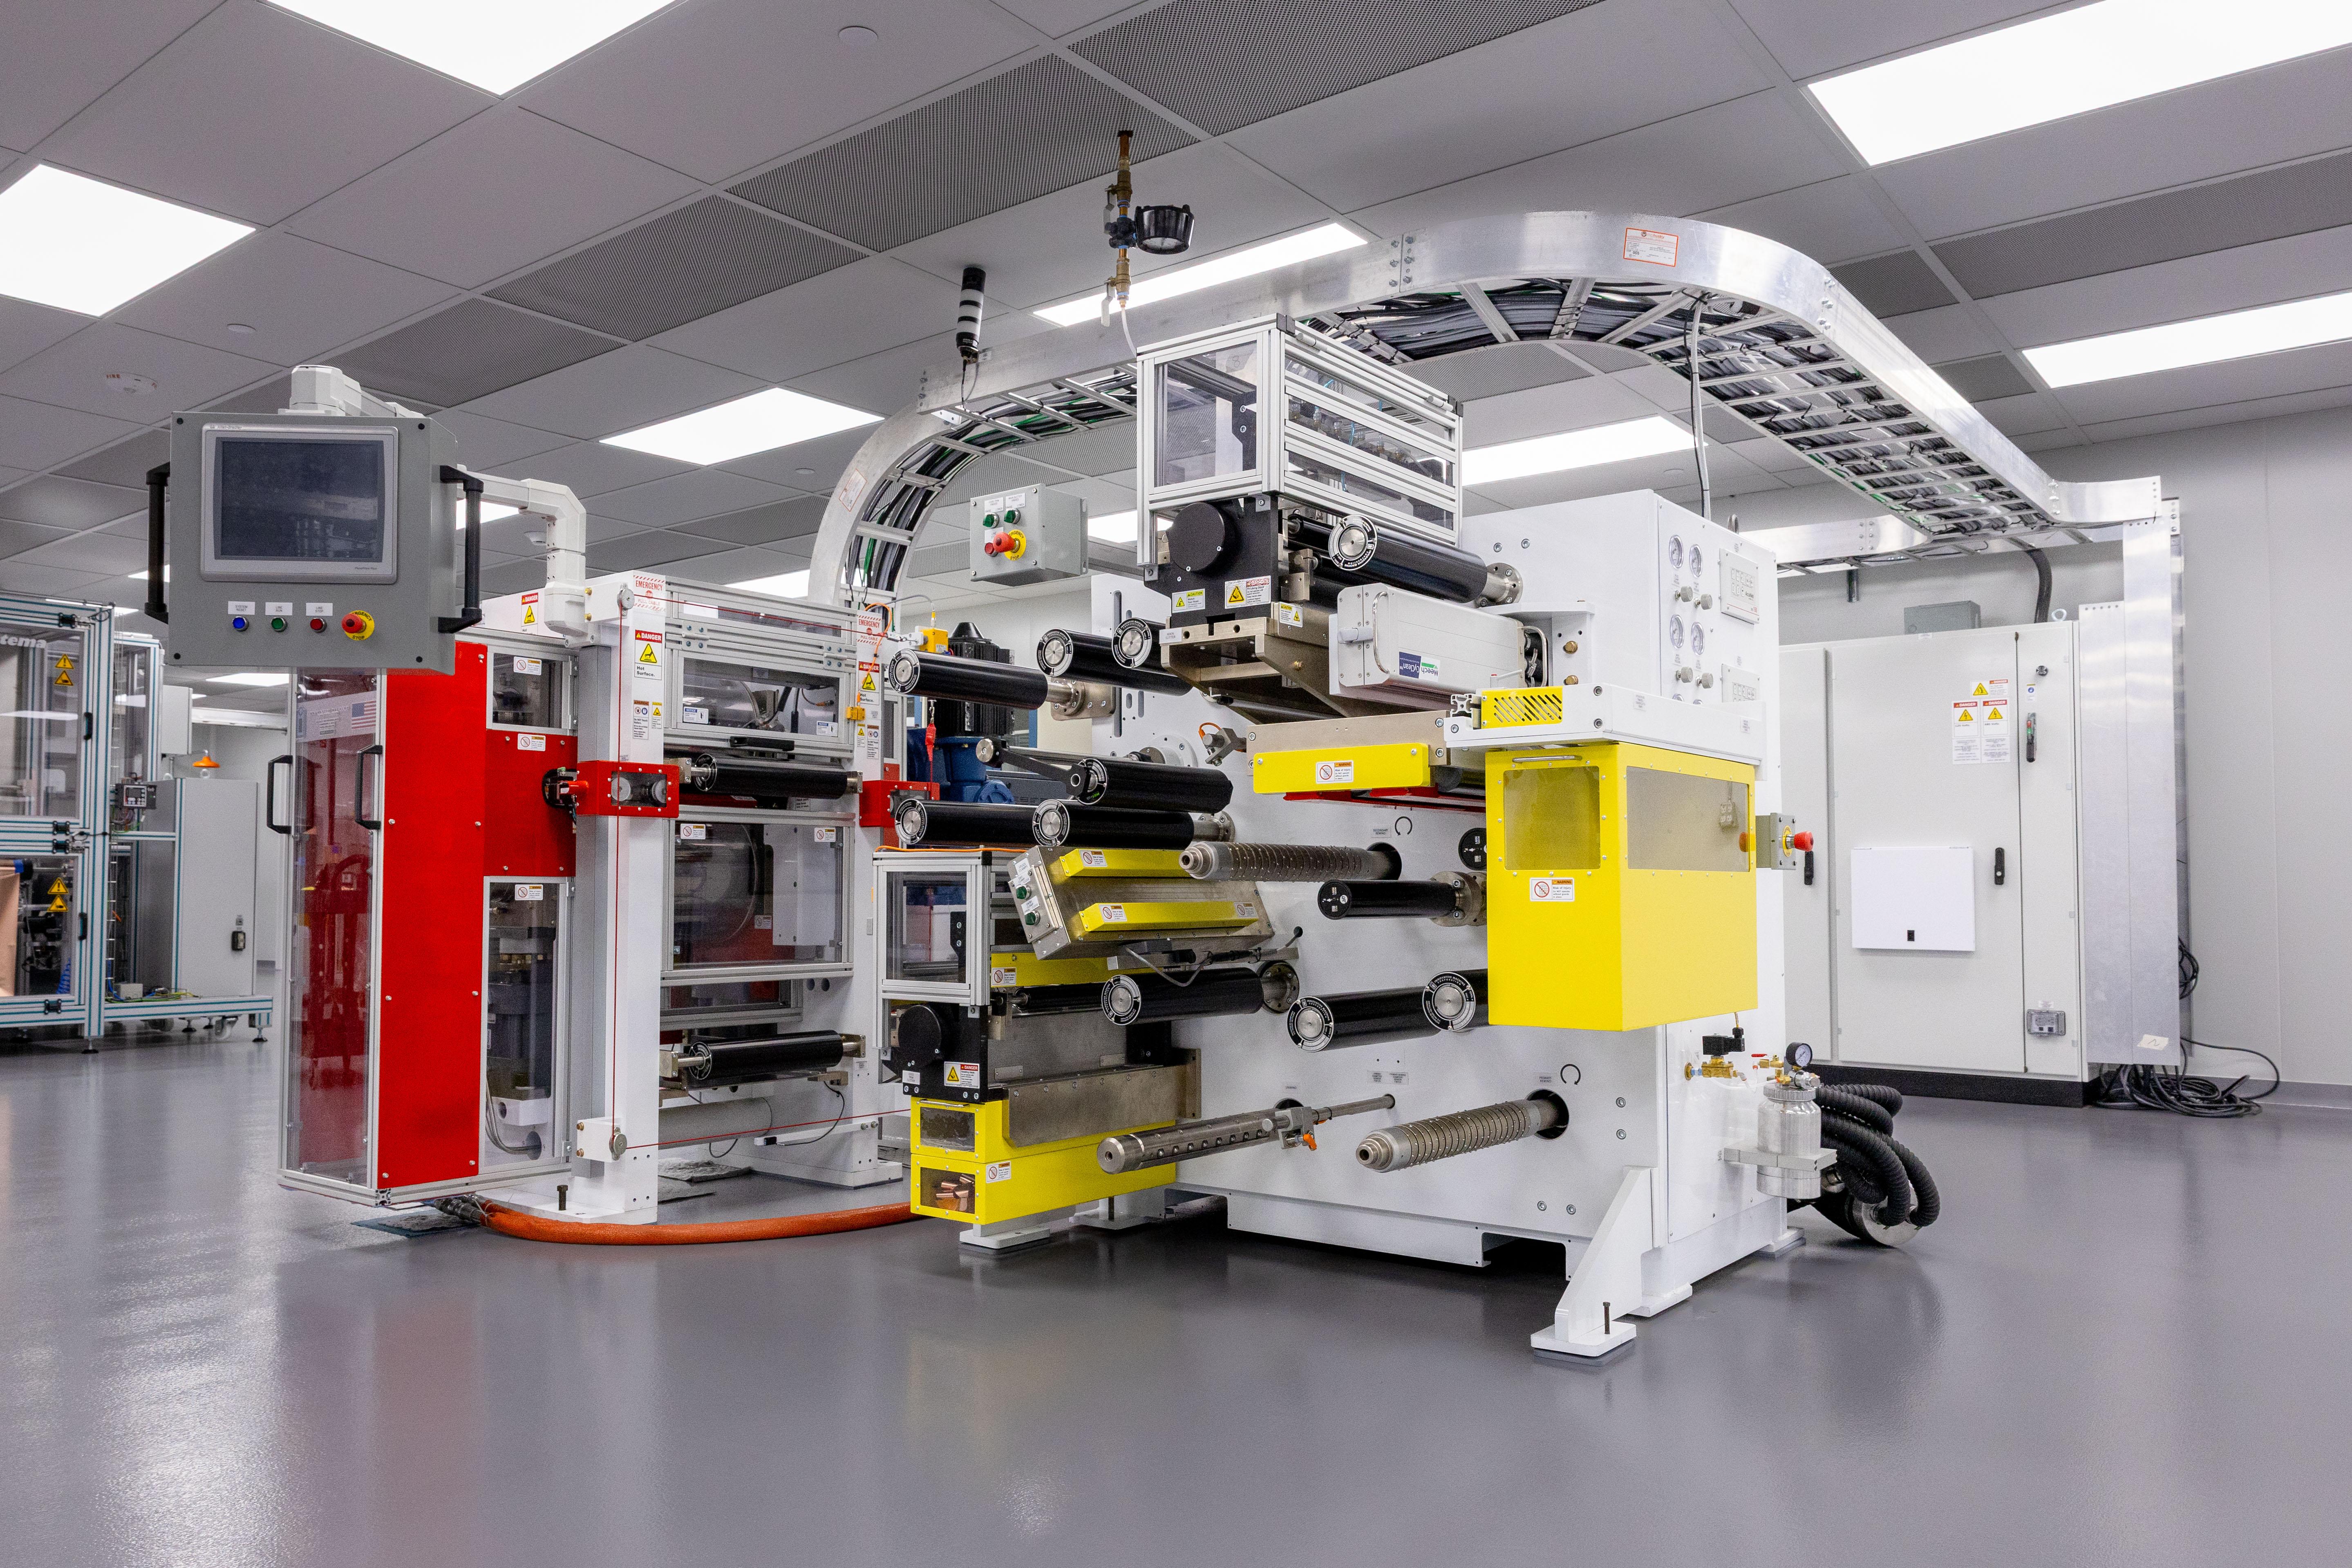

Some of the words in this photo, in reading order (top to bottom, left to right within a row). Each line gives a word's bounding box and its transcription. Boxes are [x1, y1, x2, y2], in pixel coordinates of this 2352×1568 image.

[636, 580, 663, 591] EMERGENCY
[859, 619, 879, 628] EMERGENCY
[1421, 667, 1438, 676] Meech
[1452, 976, 1466, 986] MACHINE
[1307, 1000, 1323, 1008] INNOVATIVE
[1309, 1002, 1327, 1018] CORPORATION
